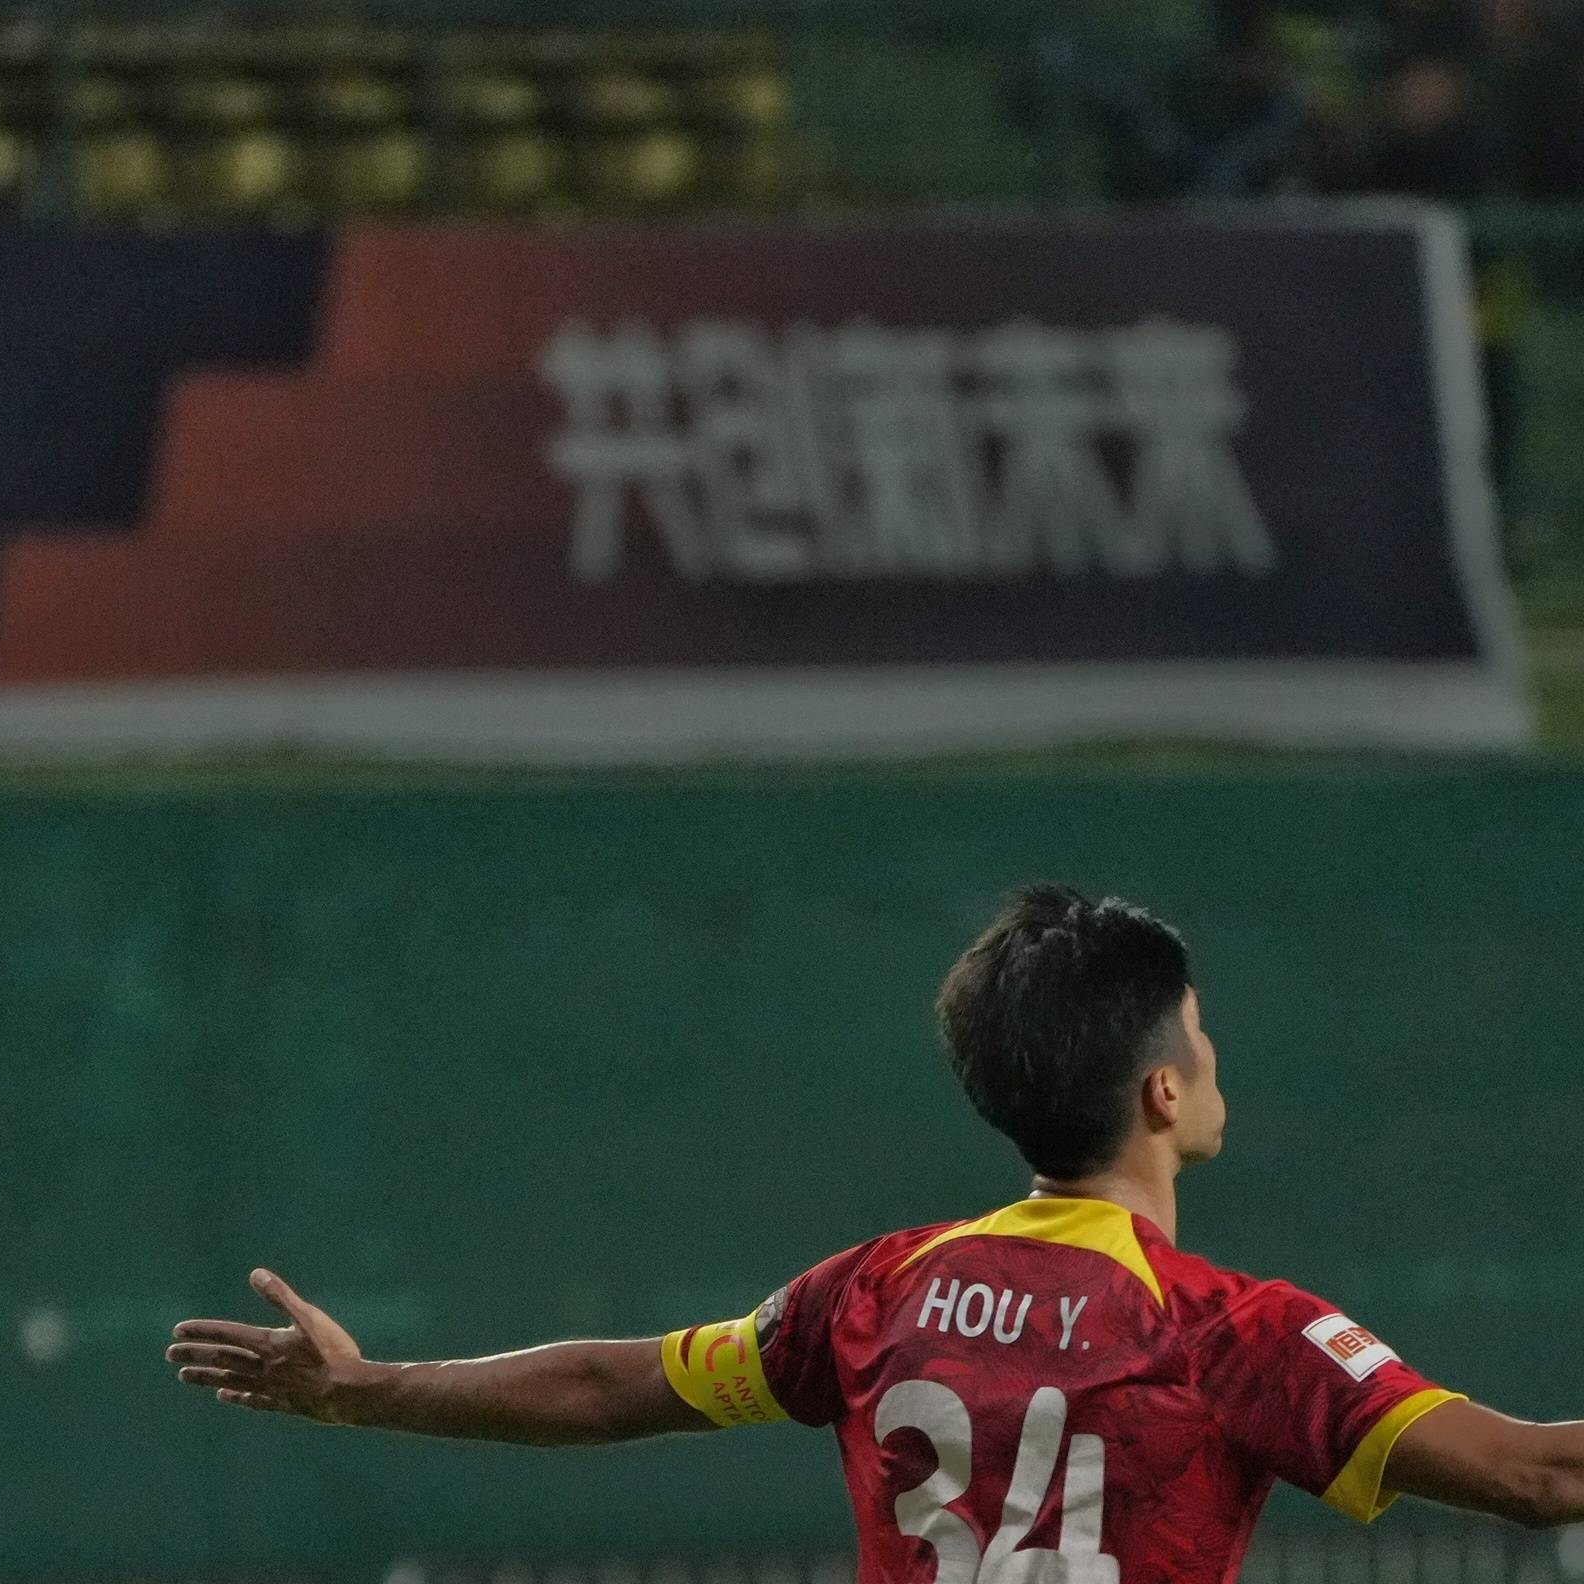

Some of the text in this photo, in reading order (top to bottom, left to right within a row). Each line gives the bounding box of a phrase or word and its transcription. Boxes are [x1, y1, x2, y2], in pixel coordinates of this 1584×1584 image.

[916, 1277, 1091, 1352] HOU Y.
[712, 1381, 743, 1422] APTA
[732, 1375, 769, 1422] ANTO
